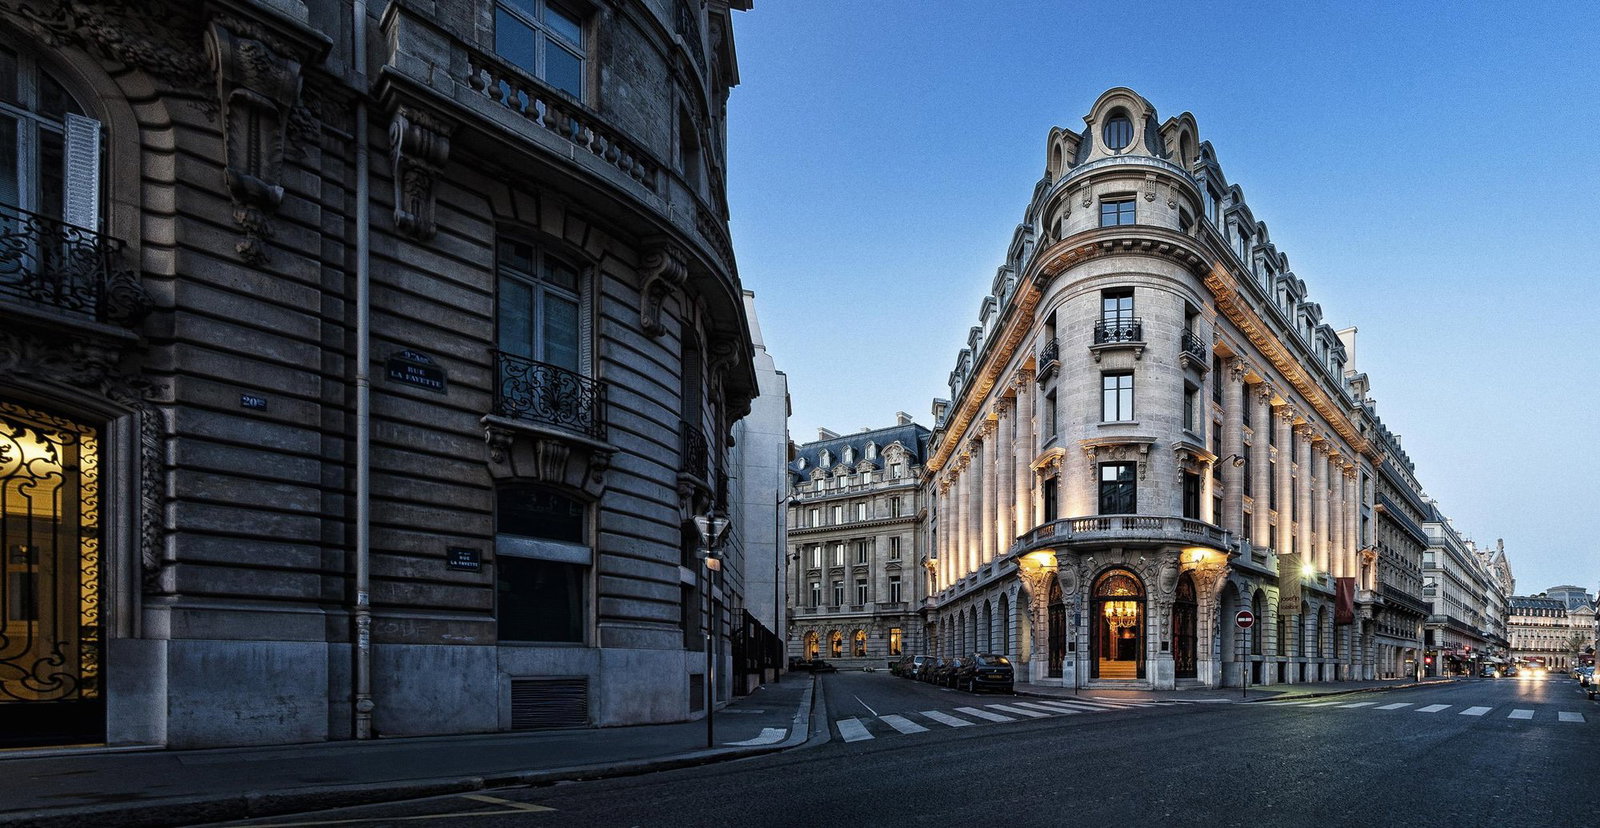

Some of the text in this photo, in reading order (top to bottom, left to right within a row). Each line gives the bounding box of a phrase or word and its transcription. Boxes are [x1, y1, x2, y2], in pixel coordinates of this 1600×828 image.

[407, 366, 424, 375] RUE
[390, 370, 441, 387] LA FAYETTE
